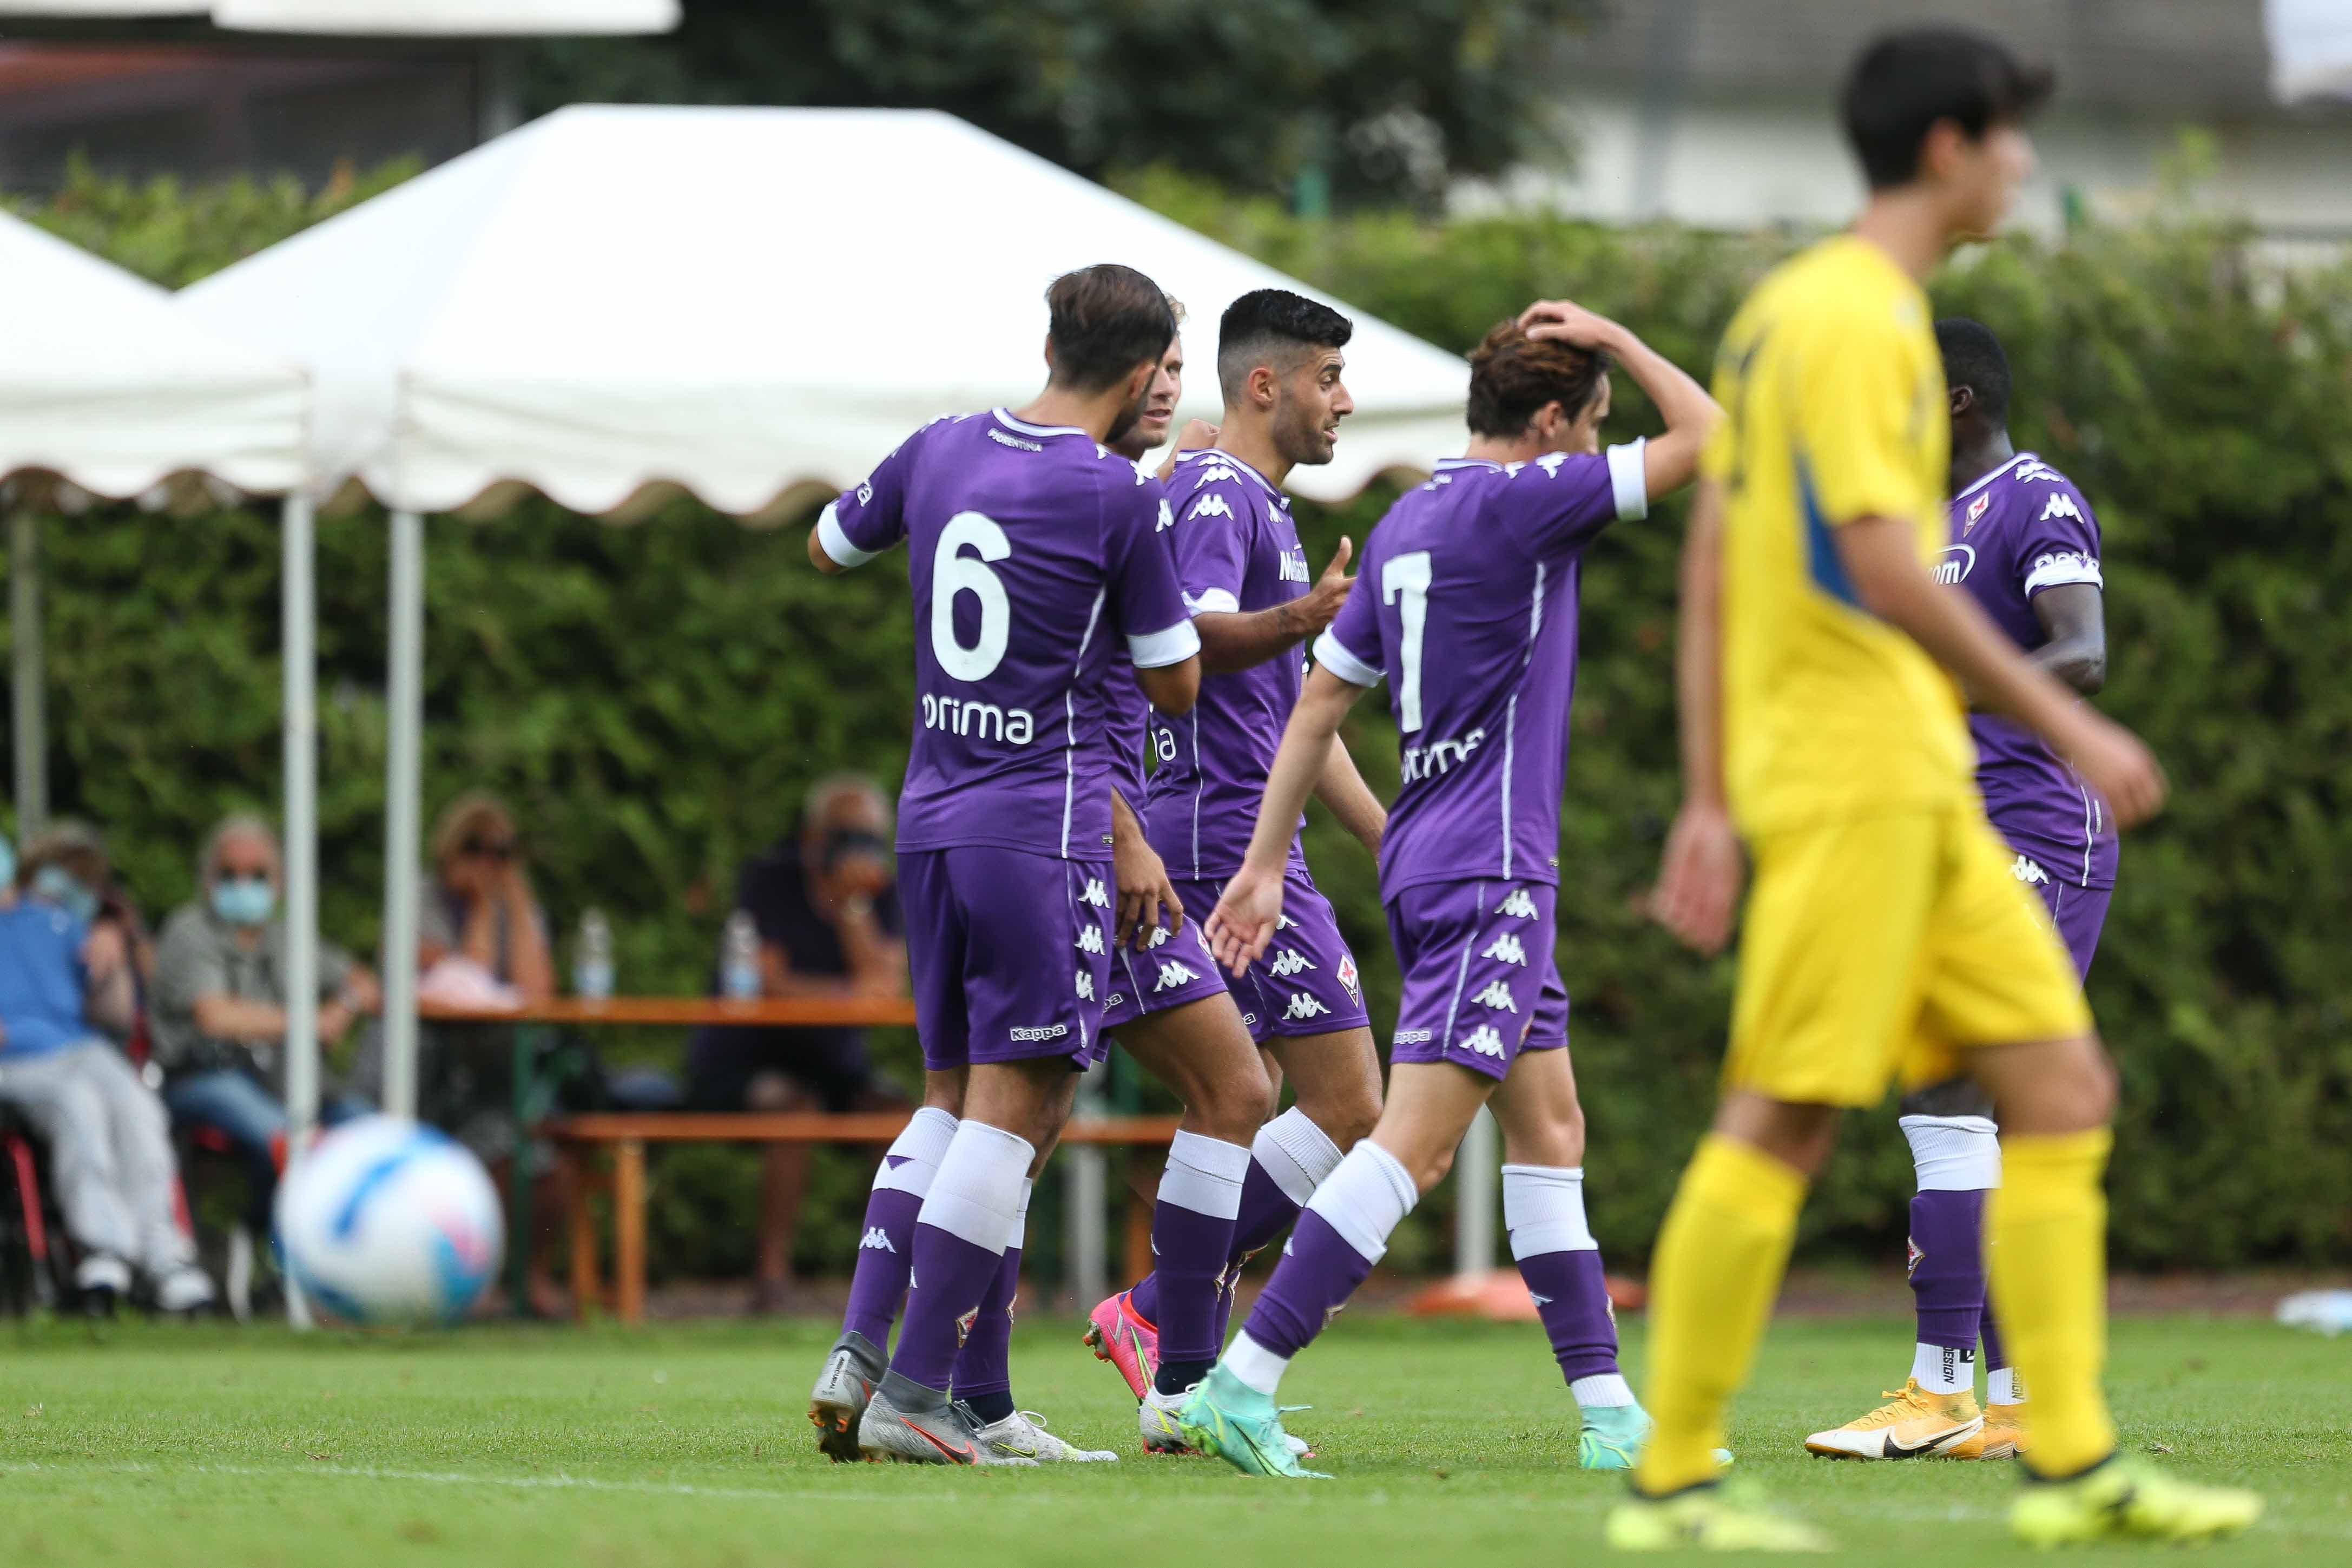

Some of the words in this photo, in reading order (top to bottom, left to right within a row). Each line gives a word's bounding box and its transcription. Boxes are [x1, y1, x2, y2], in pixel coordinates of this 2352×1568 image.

[931, 510, 1012, 682] 6
[1381, 550, 1433, 733] 7
[1010, 1024, 1068, 1042] Kappa
[1393, 1030, 1433, 1045] appa
